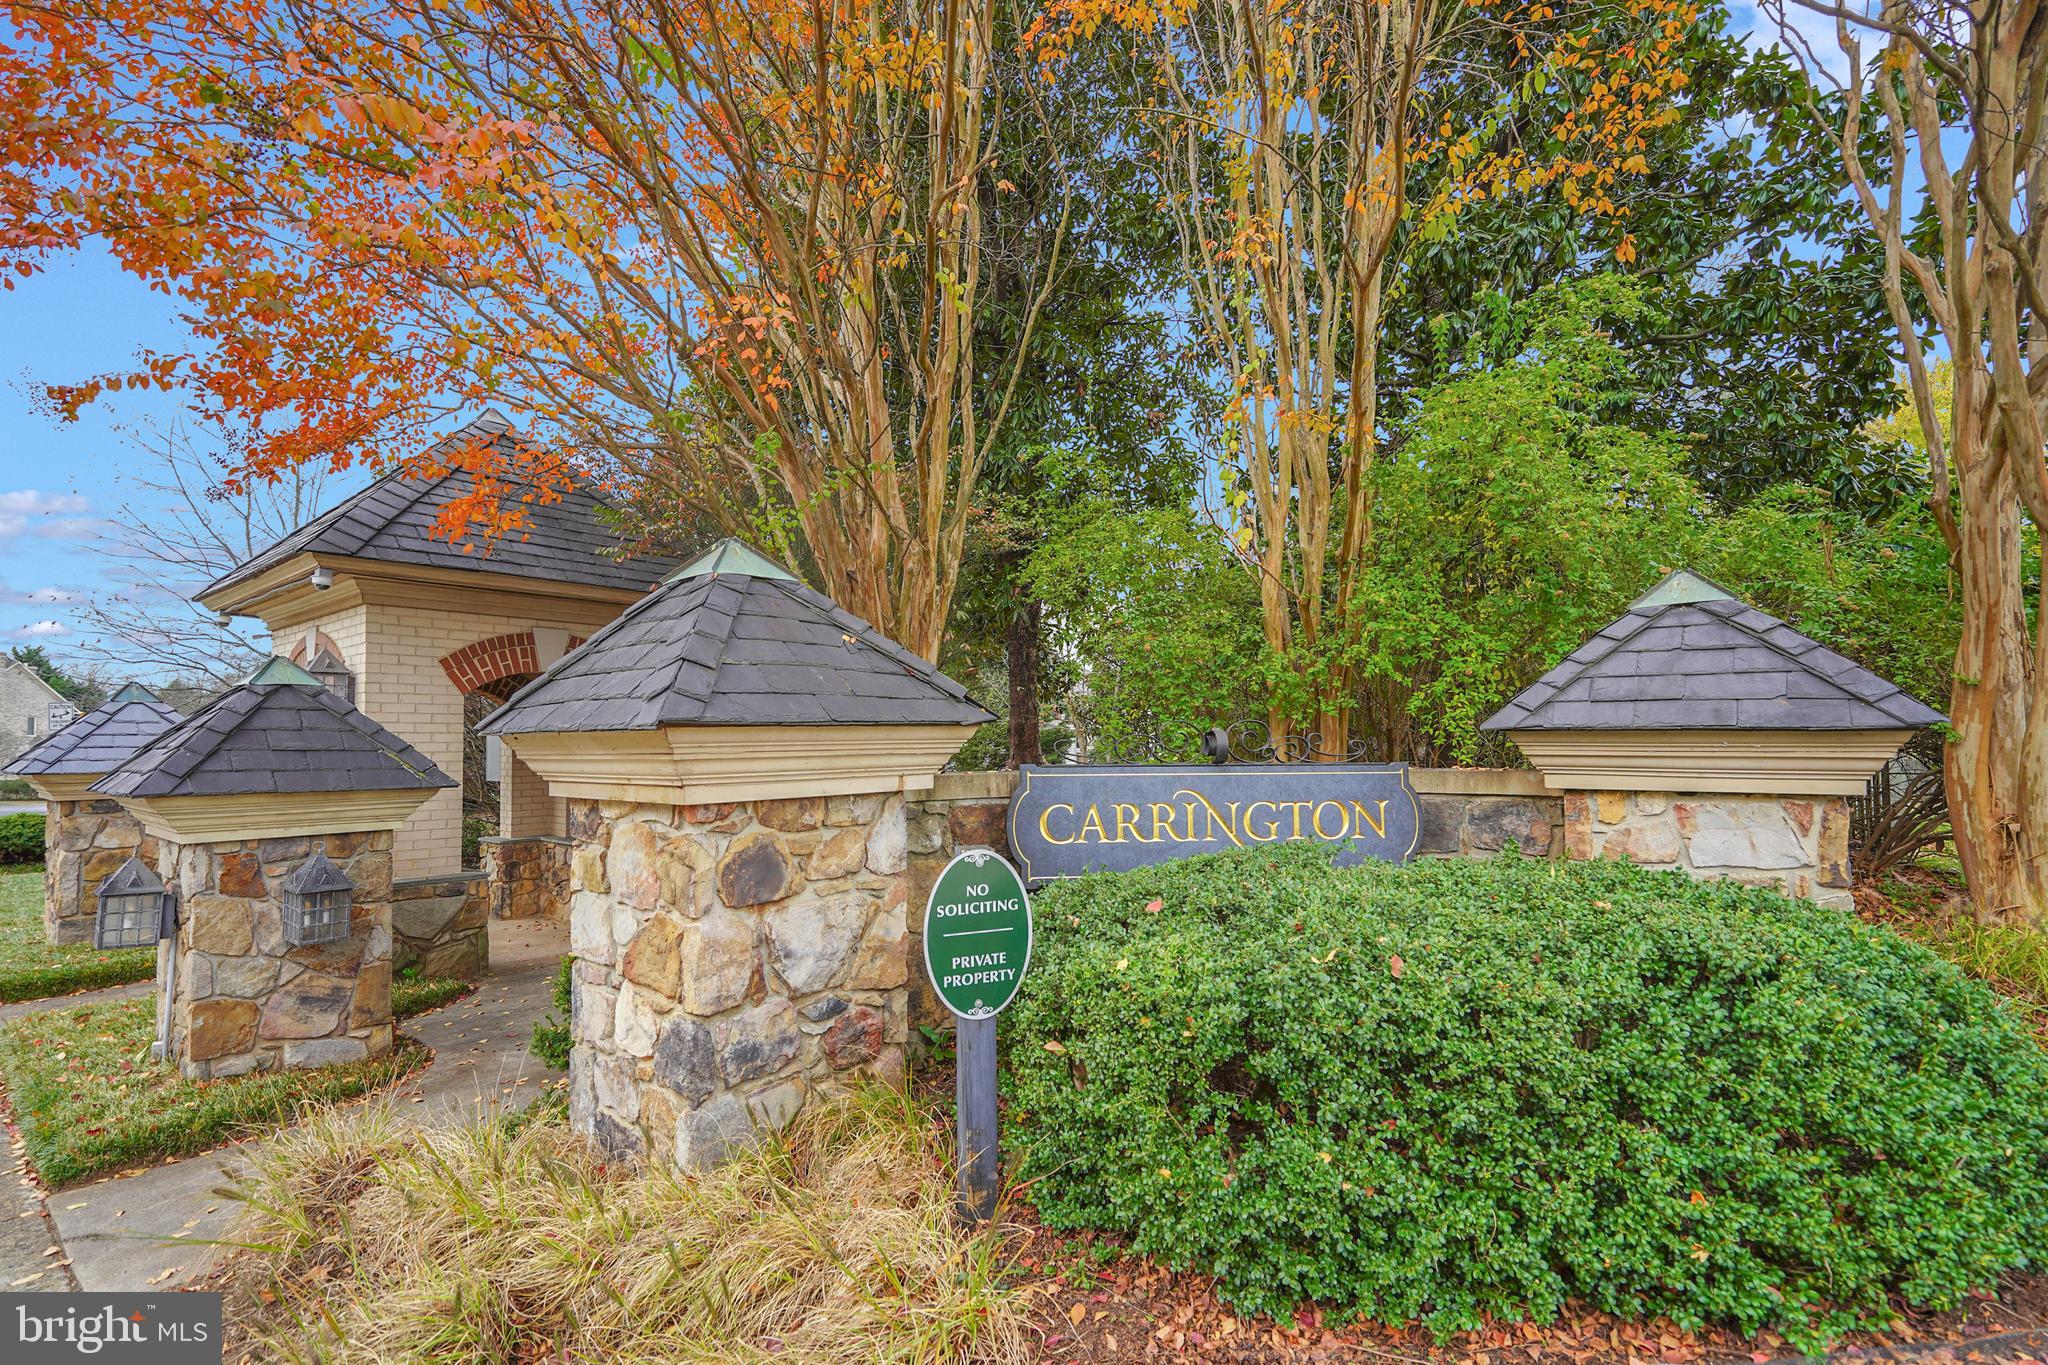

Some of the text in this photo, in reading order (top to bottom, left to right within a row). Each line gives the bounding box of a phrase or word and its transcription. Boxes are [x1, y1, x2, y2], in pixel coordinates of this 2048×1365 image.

[1039, 788, 1390, 847] CARRINGTON
[966, 883, 989, 897] NO
[936, 898, 1019, 918] SOLICITING
[952, 952, 1007, 969] PRIVATE
[943, 968, 1016, 988] PROPERTY
